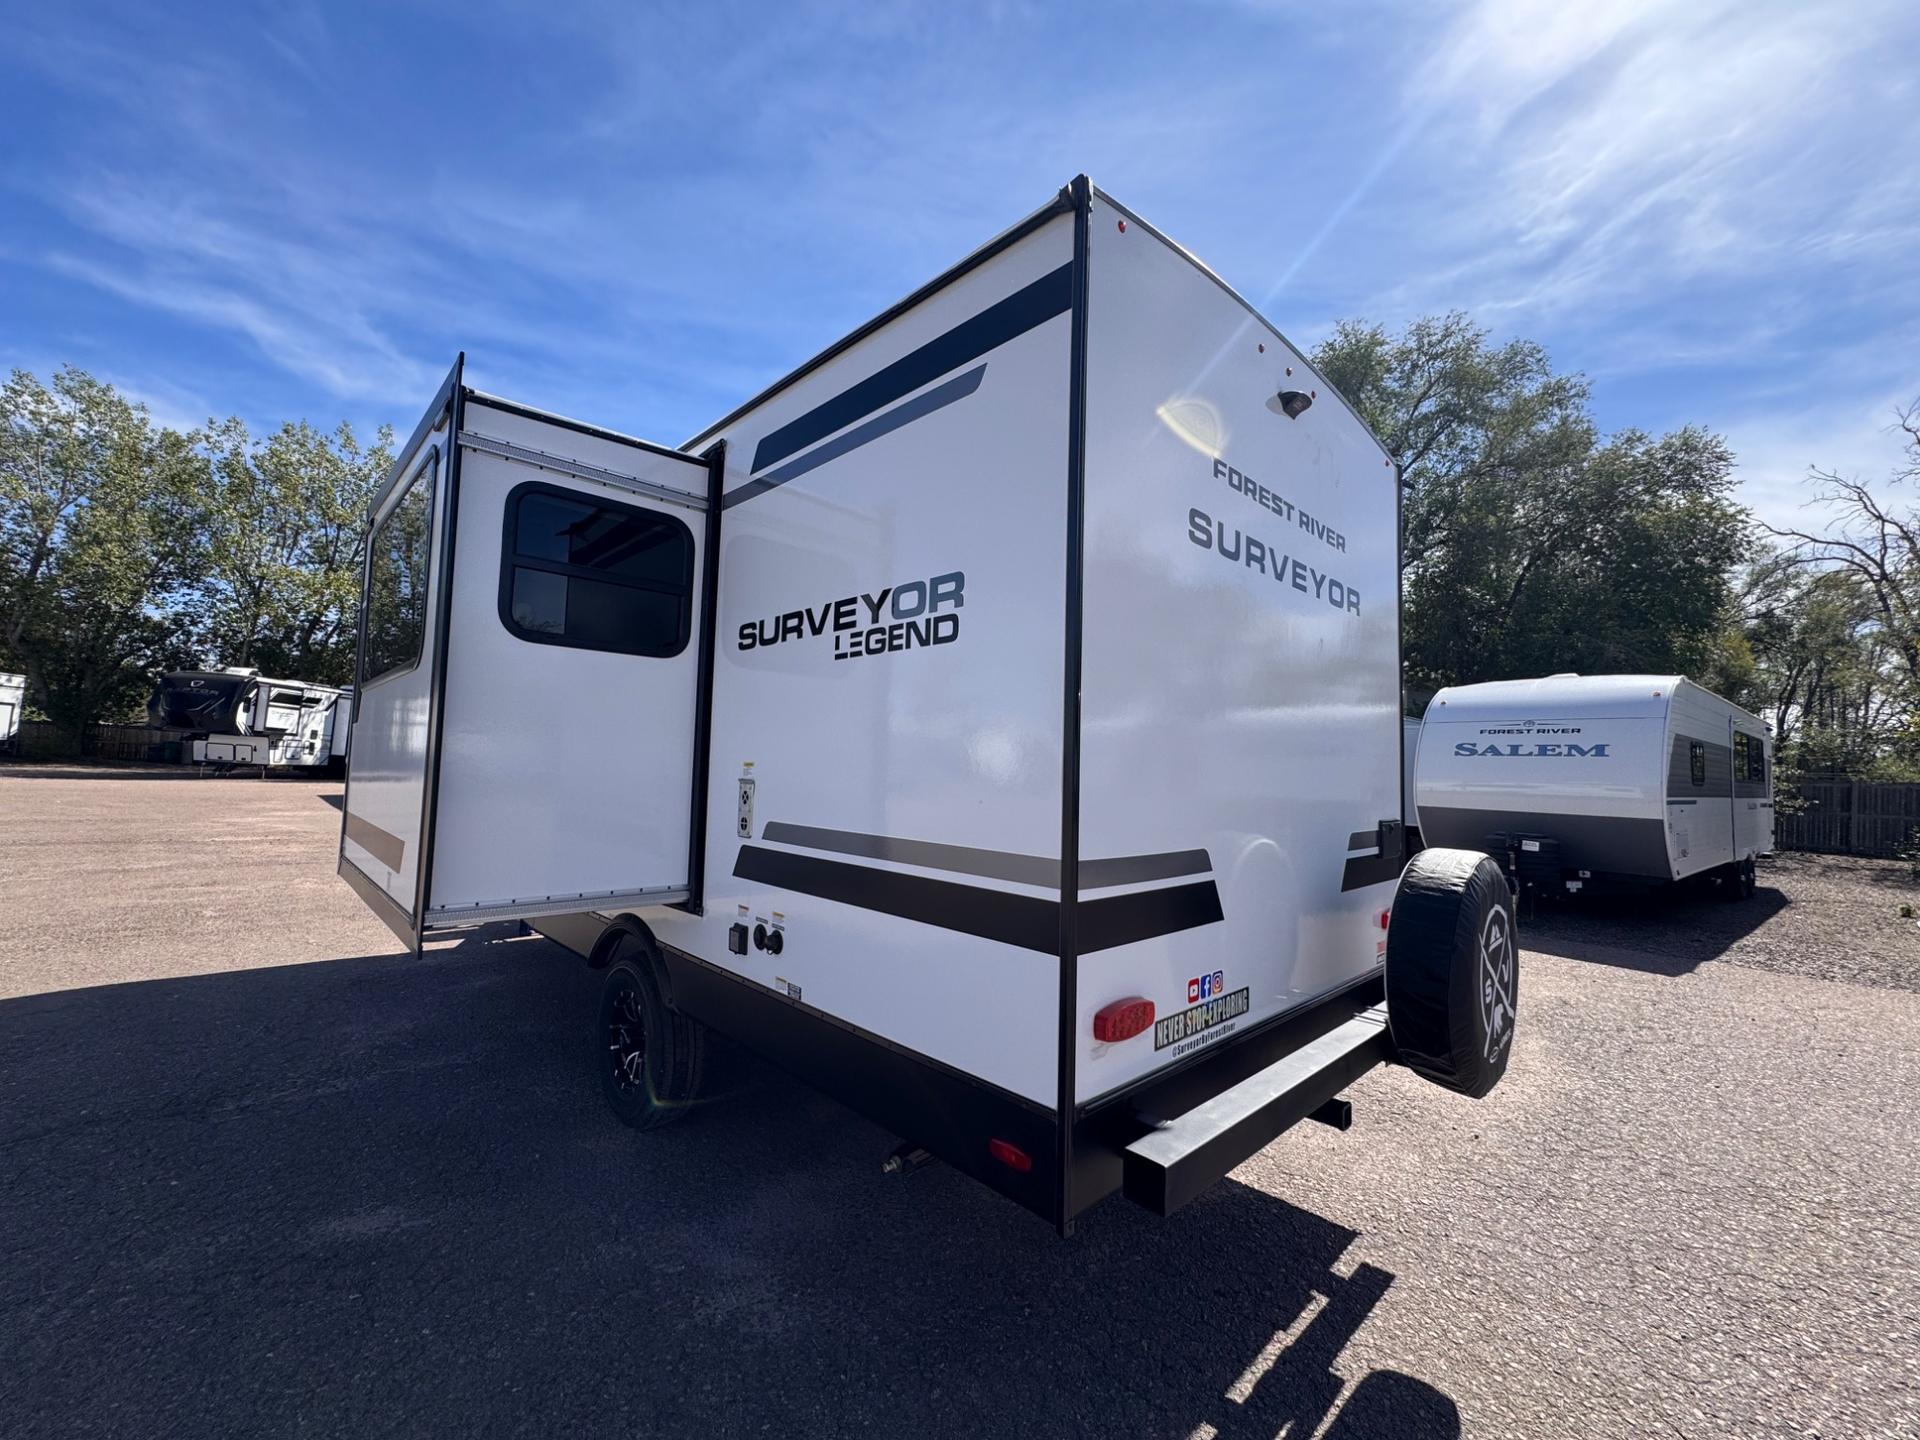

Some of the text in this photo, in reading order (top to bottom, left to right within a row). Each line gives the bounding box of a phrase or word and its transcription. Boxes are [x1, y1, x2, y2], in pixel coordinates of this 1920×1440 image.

[1213, 457, 1346, 553] FOREST RIVER
[1188, 508, 1360, 616] SURVEYOR
[738, 571, 965, 650] SURVEYOR
[835, 613, 959, 660] LEGEND
[1454, 742, 1610, 757] SALEM
[1157, 1014, 1184, 1048] NEVER
